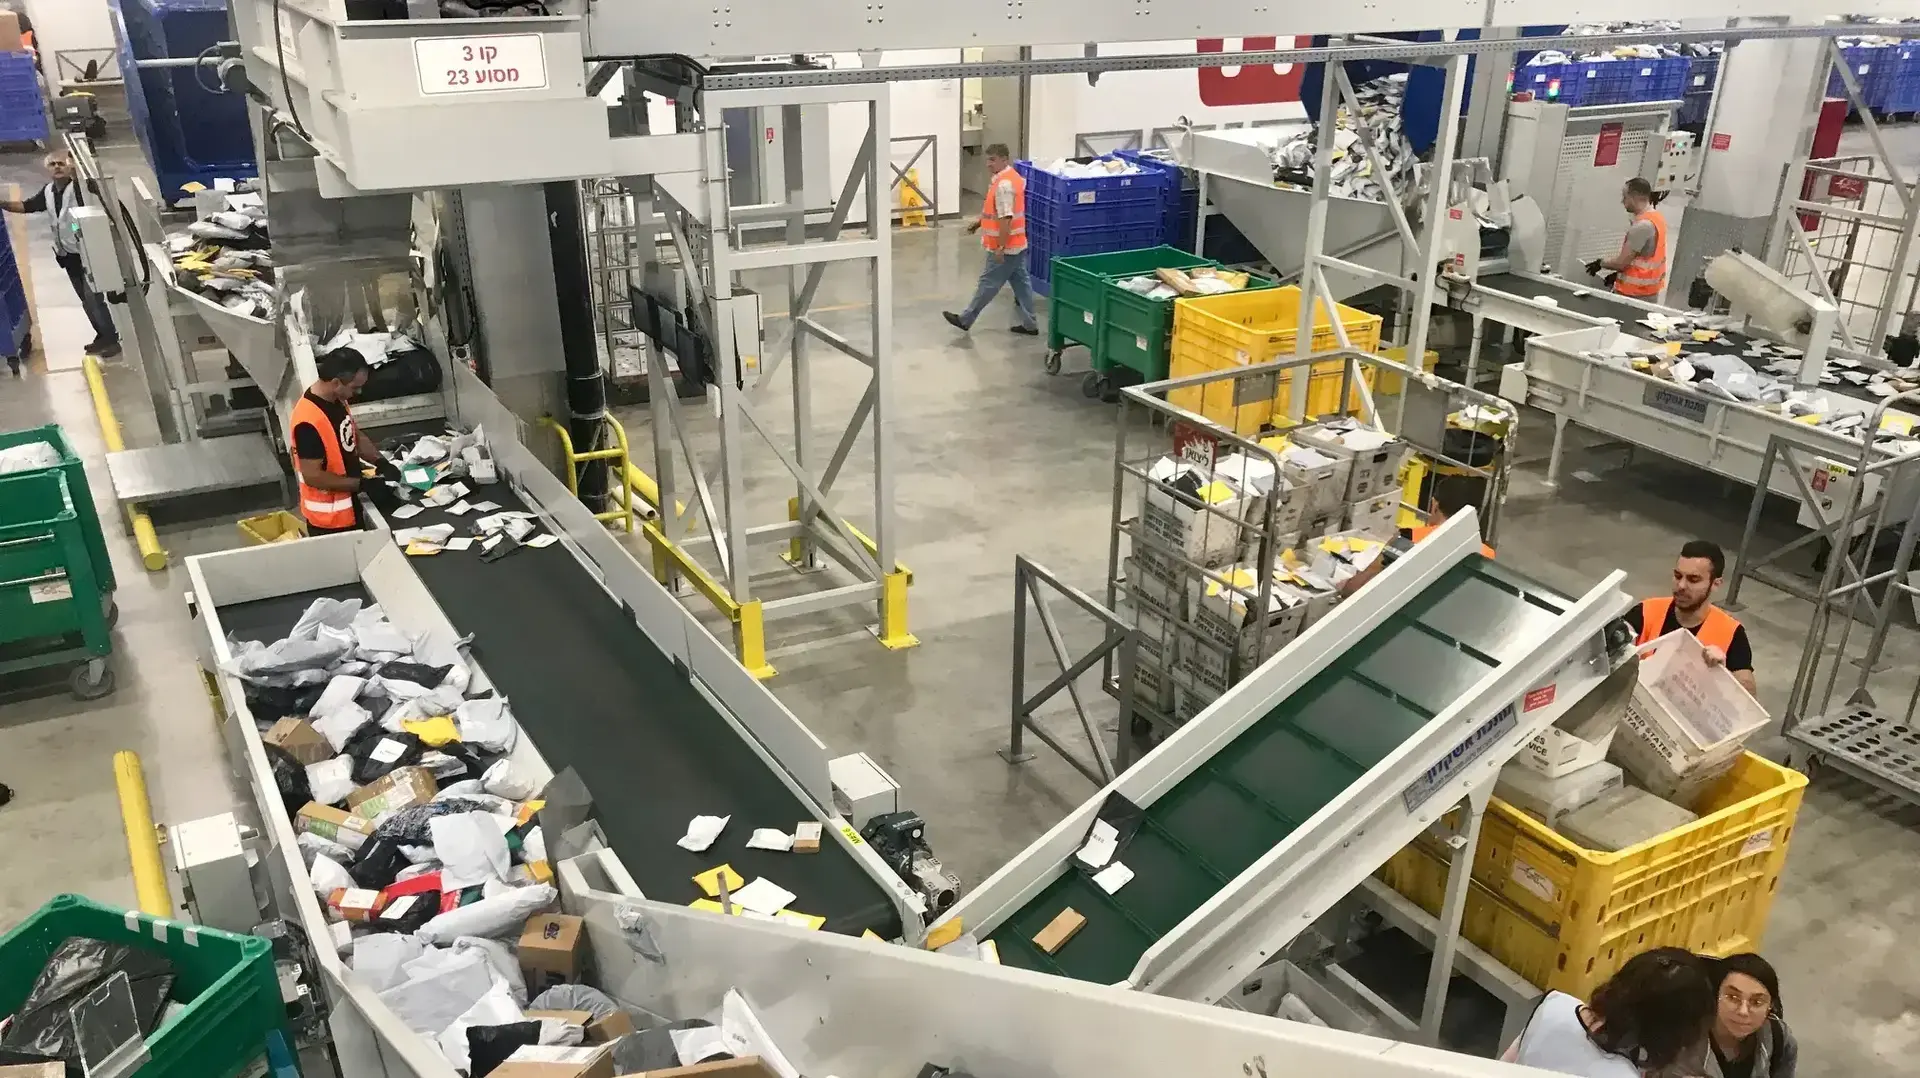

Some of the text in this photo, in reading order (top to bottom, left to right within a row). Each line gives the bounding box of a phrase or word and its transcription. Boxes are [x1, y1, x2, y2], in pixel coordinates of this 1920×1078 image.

[462, 45, 498, 65] קו 3
[446, 67, 520, 86] מסוע 23
[1526, 741, 1548, 757] VICE
[1644, 726, 1673, 759] STATES
